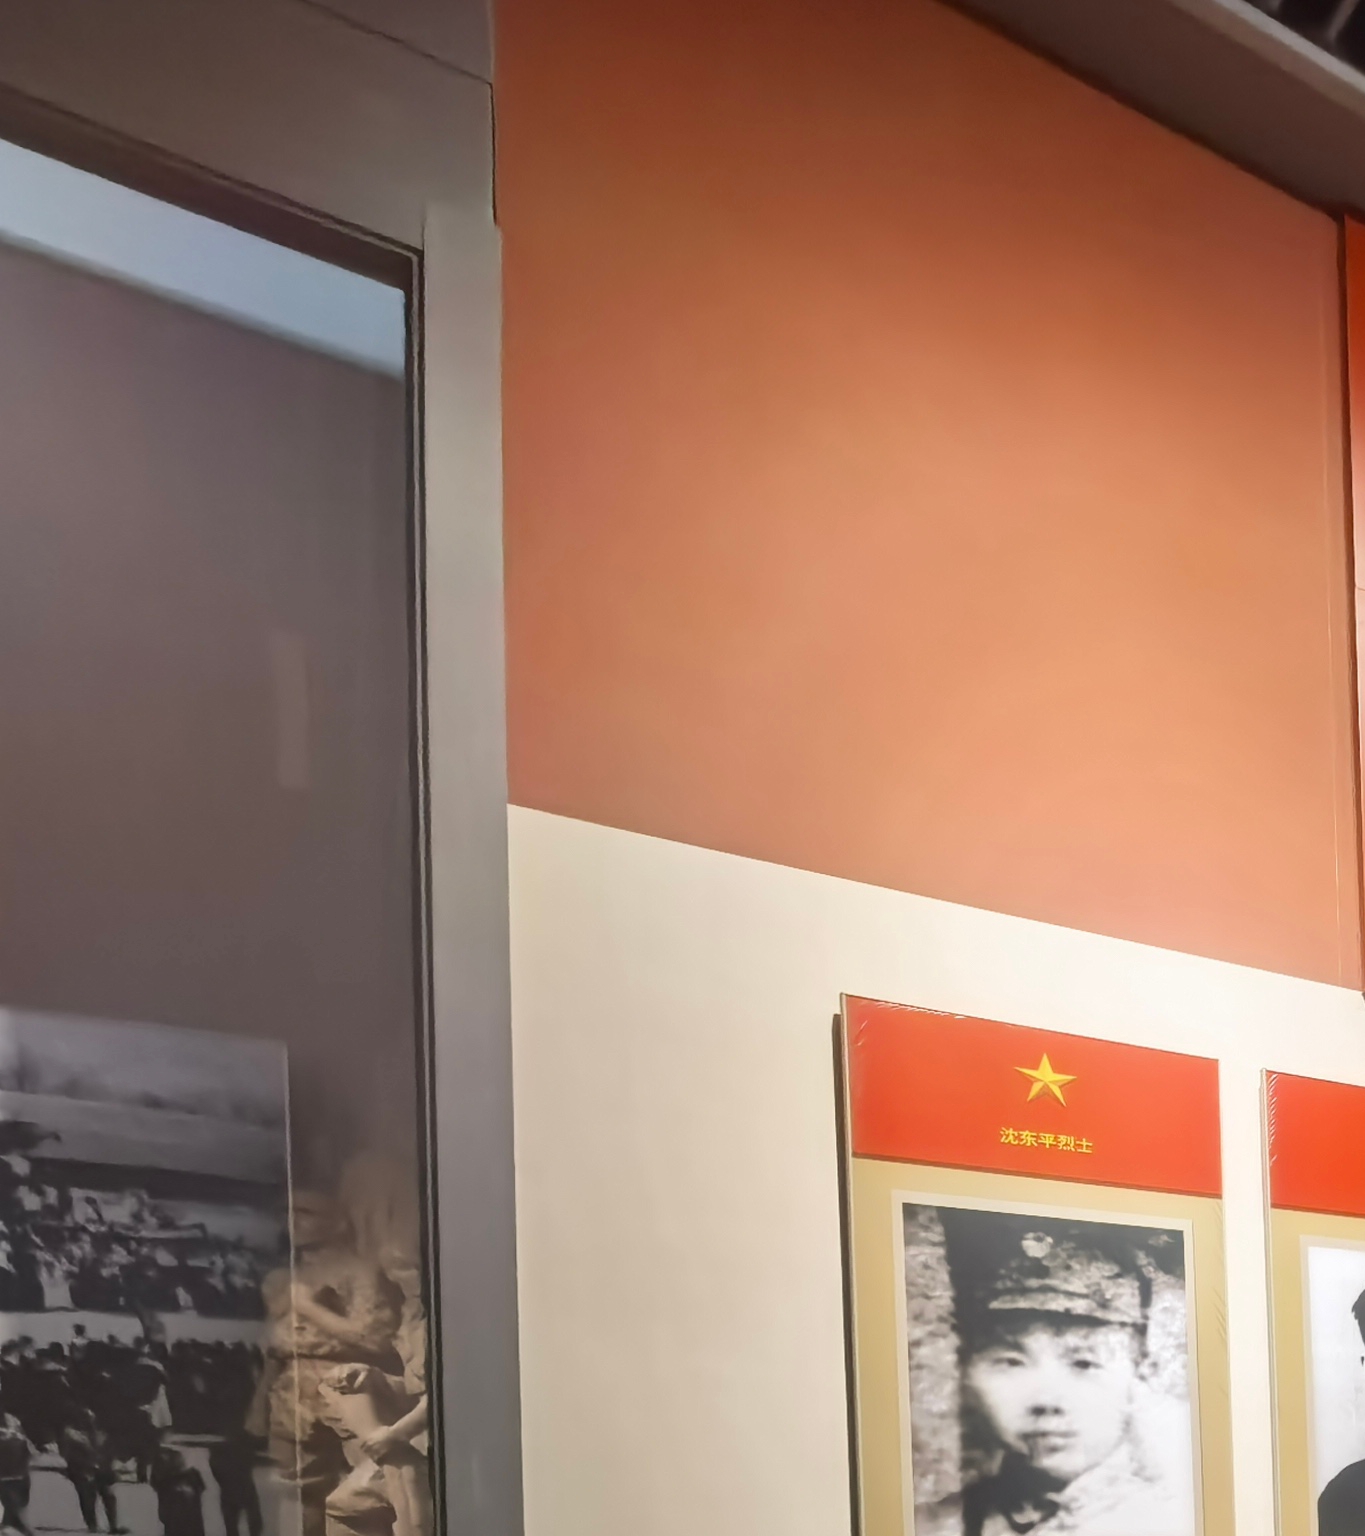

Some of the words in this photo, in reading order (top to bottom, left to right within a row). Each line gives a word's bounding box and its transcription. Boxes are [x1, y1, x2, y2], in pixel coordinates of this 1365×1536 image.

[1000, 1127, 1093, 1153] 沈东平烈士
